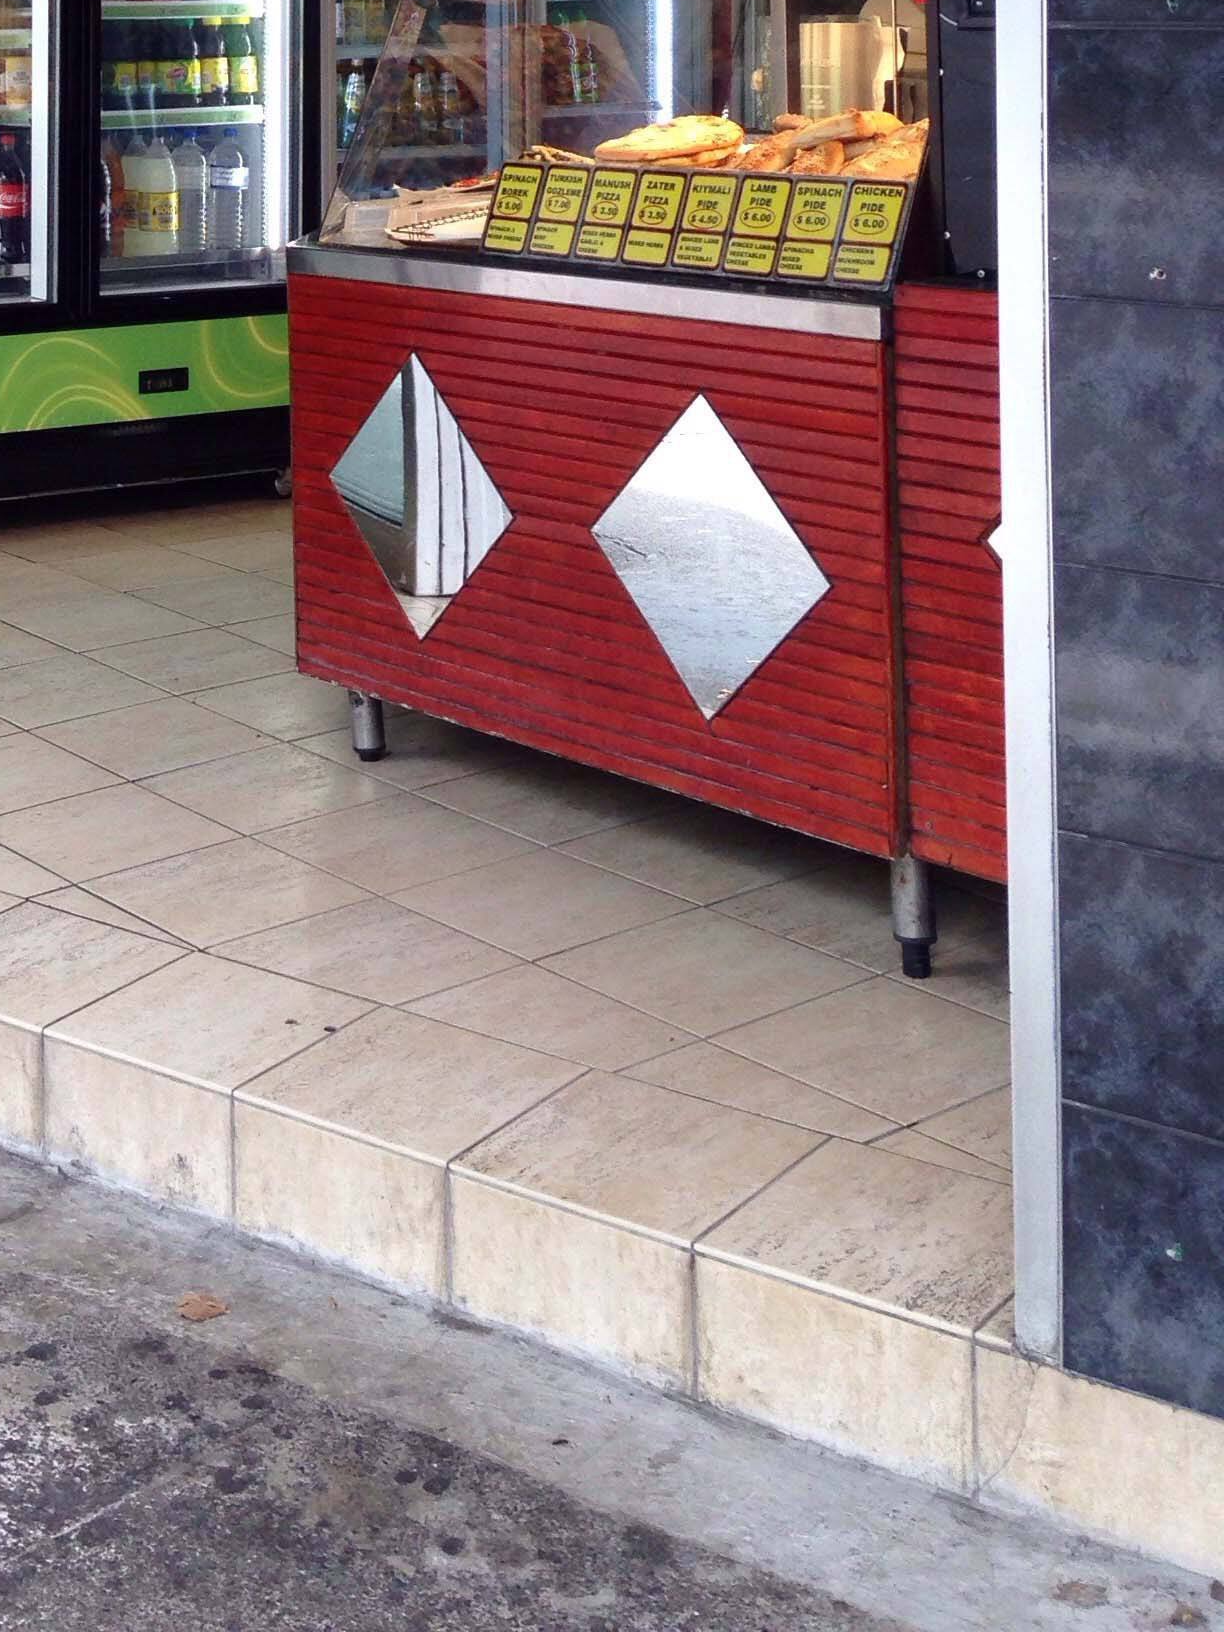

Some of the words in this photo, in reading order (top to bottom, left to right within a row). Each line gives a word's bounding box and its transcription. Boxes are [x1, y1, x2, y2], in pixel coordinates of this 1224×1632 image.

[503, 174, 537, 183] SPINACH
[551, 174, 582, 183] TURKISH
[595, 179, 631, 189] MANUSH
[647, 181, 675, 190] ZATER
[751, 184, 777, 193] LAMB
[693, 185, 730, 194] KIYMALI
[798, 187, 842, 197] SPINACH
[855, 186, 903, 197] CHICKEN
[596, 192, 620, 201] PIZZA
[644, 195, 668, 205] PIZZA
[697, 200, 718, 209] PIDE
[750, 197, 773, 207] PIDE
[803, 200, 827, 210] PIDE
[861, 203, 885, 212] PIDE
[700, 215, 718, 224] 4.50
[752, 213, 771, 222] 6.00
[805, 216, 826, 225] 6.00
[863, 219, 884, 228] 6.00
